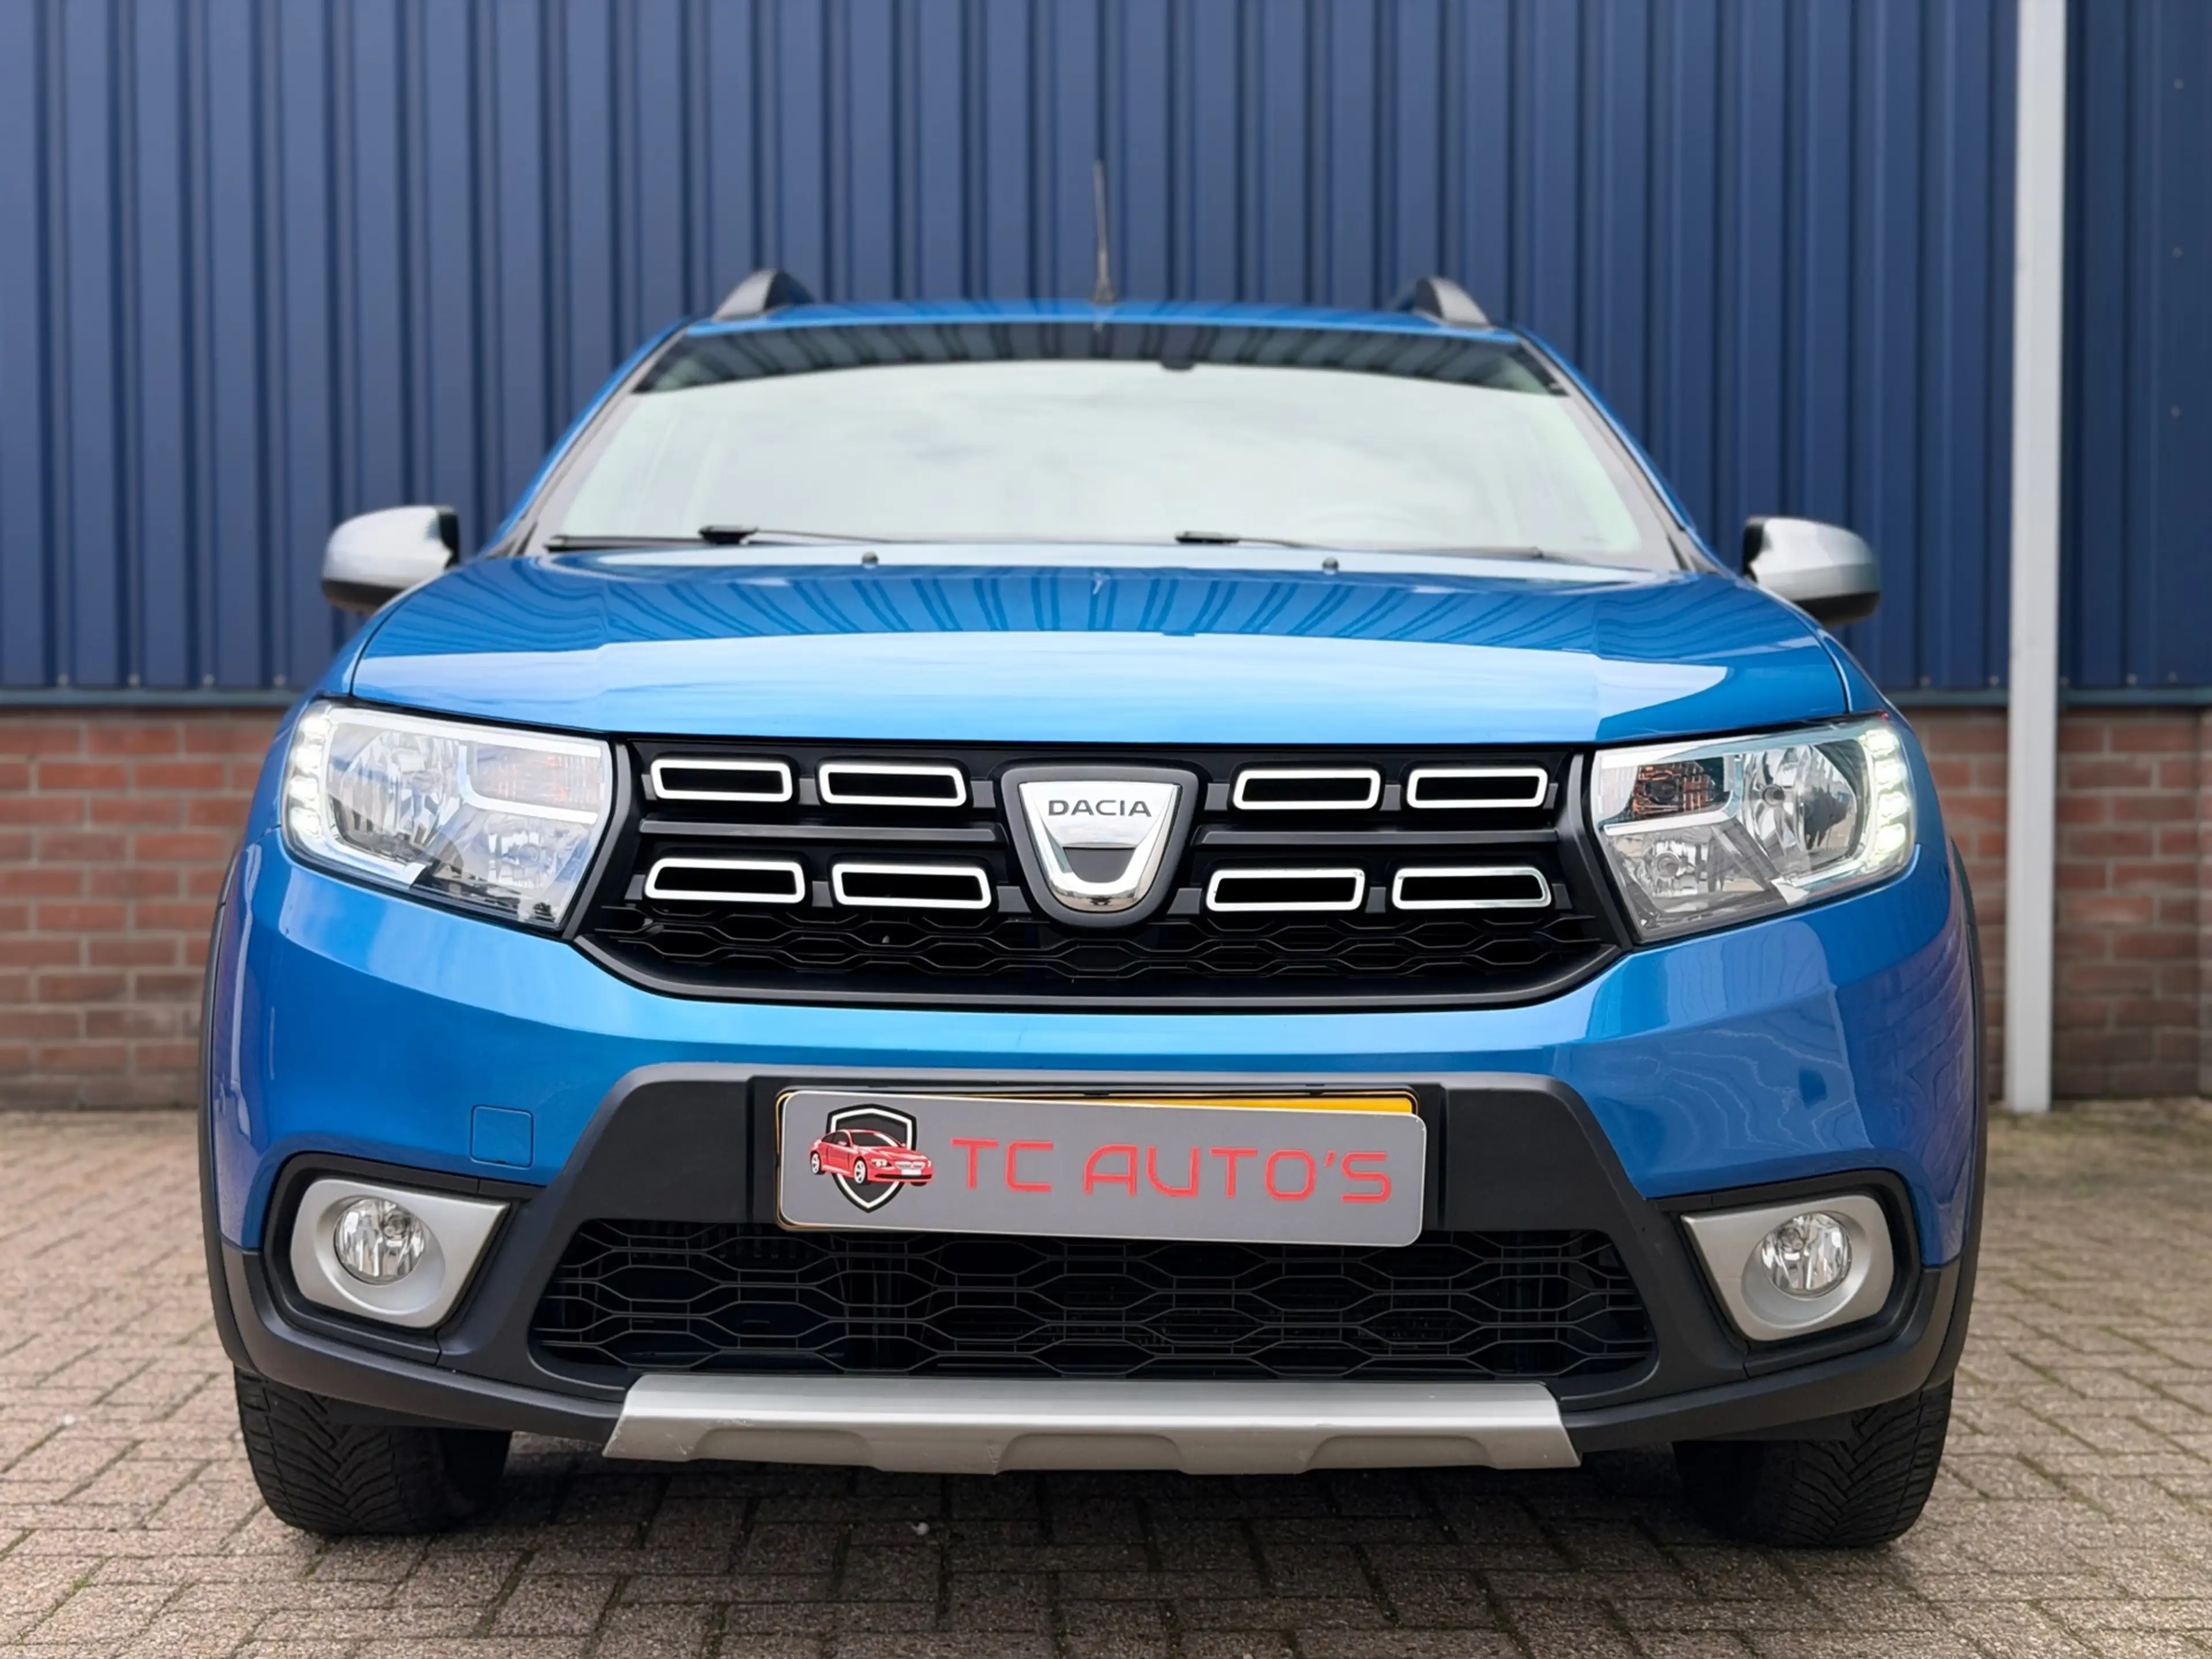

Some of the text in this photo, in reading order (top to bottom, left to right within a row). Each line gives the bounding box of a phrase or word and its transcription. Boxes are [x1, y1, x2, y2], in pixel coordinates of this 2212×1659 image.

[1048, 800, 1152, 817] DACIA
[951, 1138, 1392, 1203] TC AUTO'S
